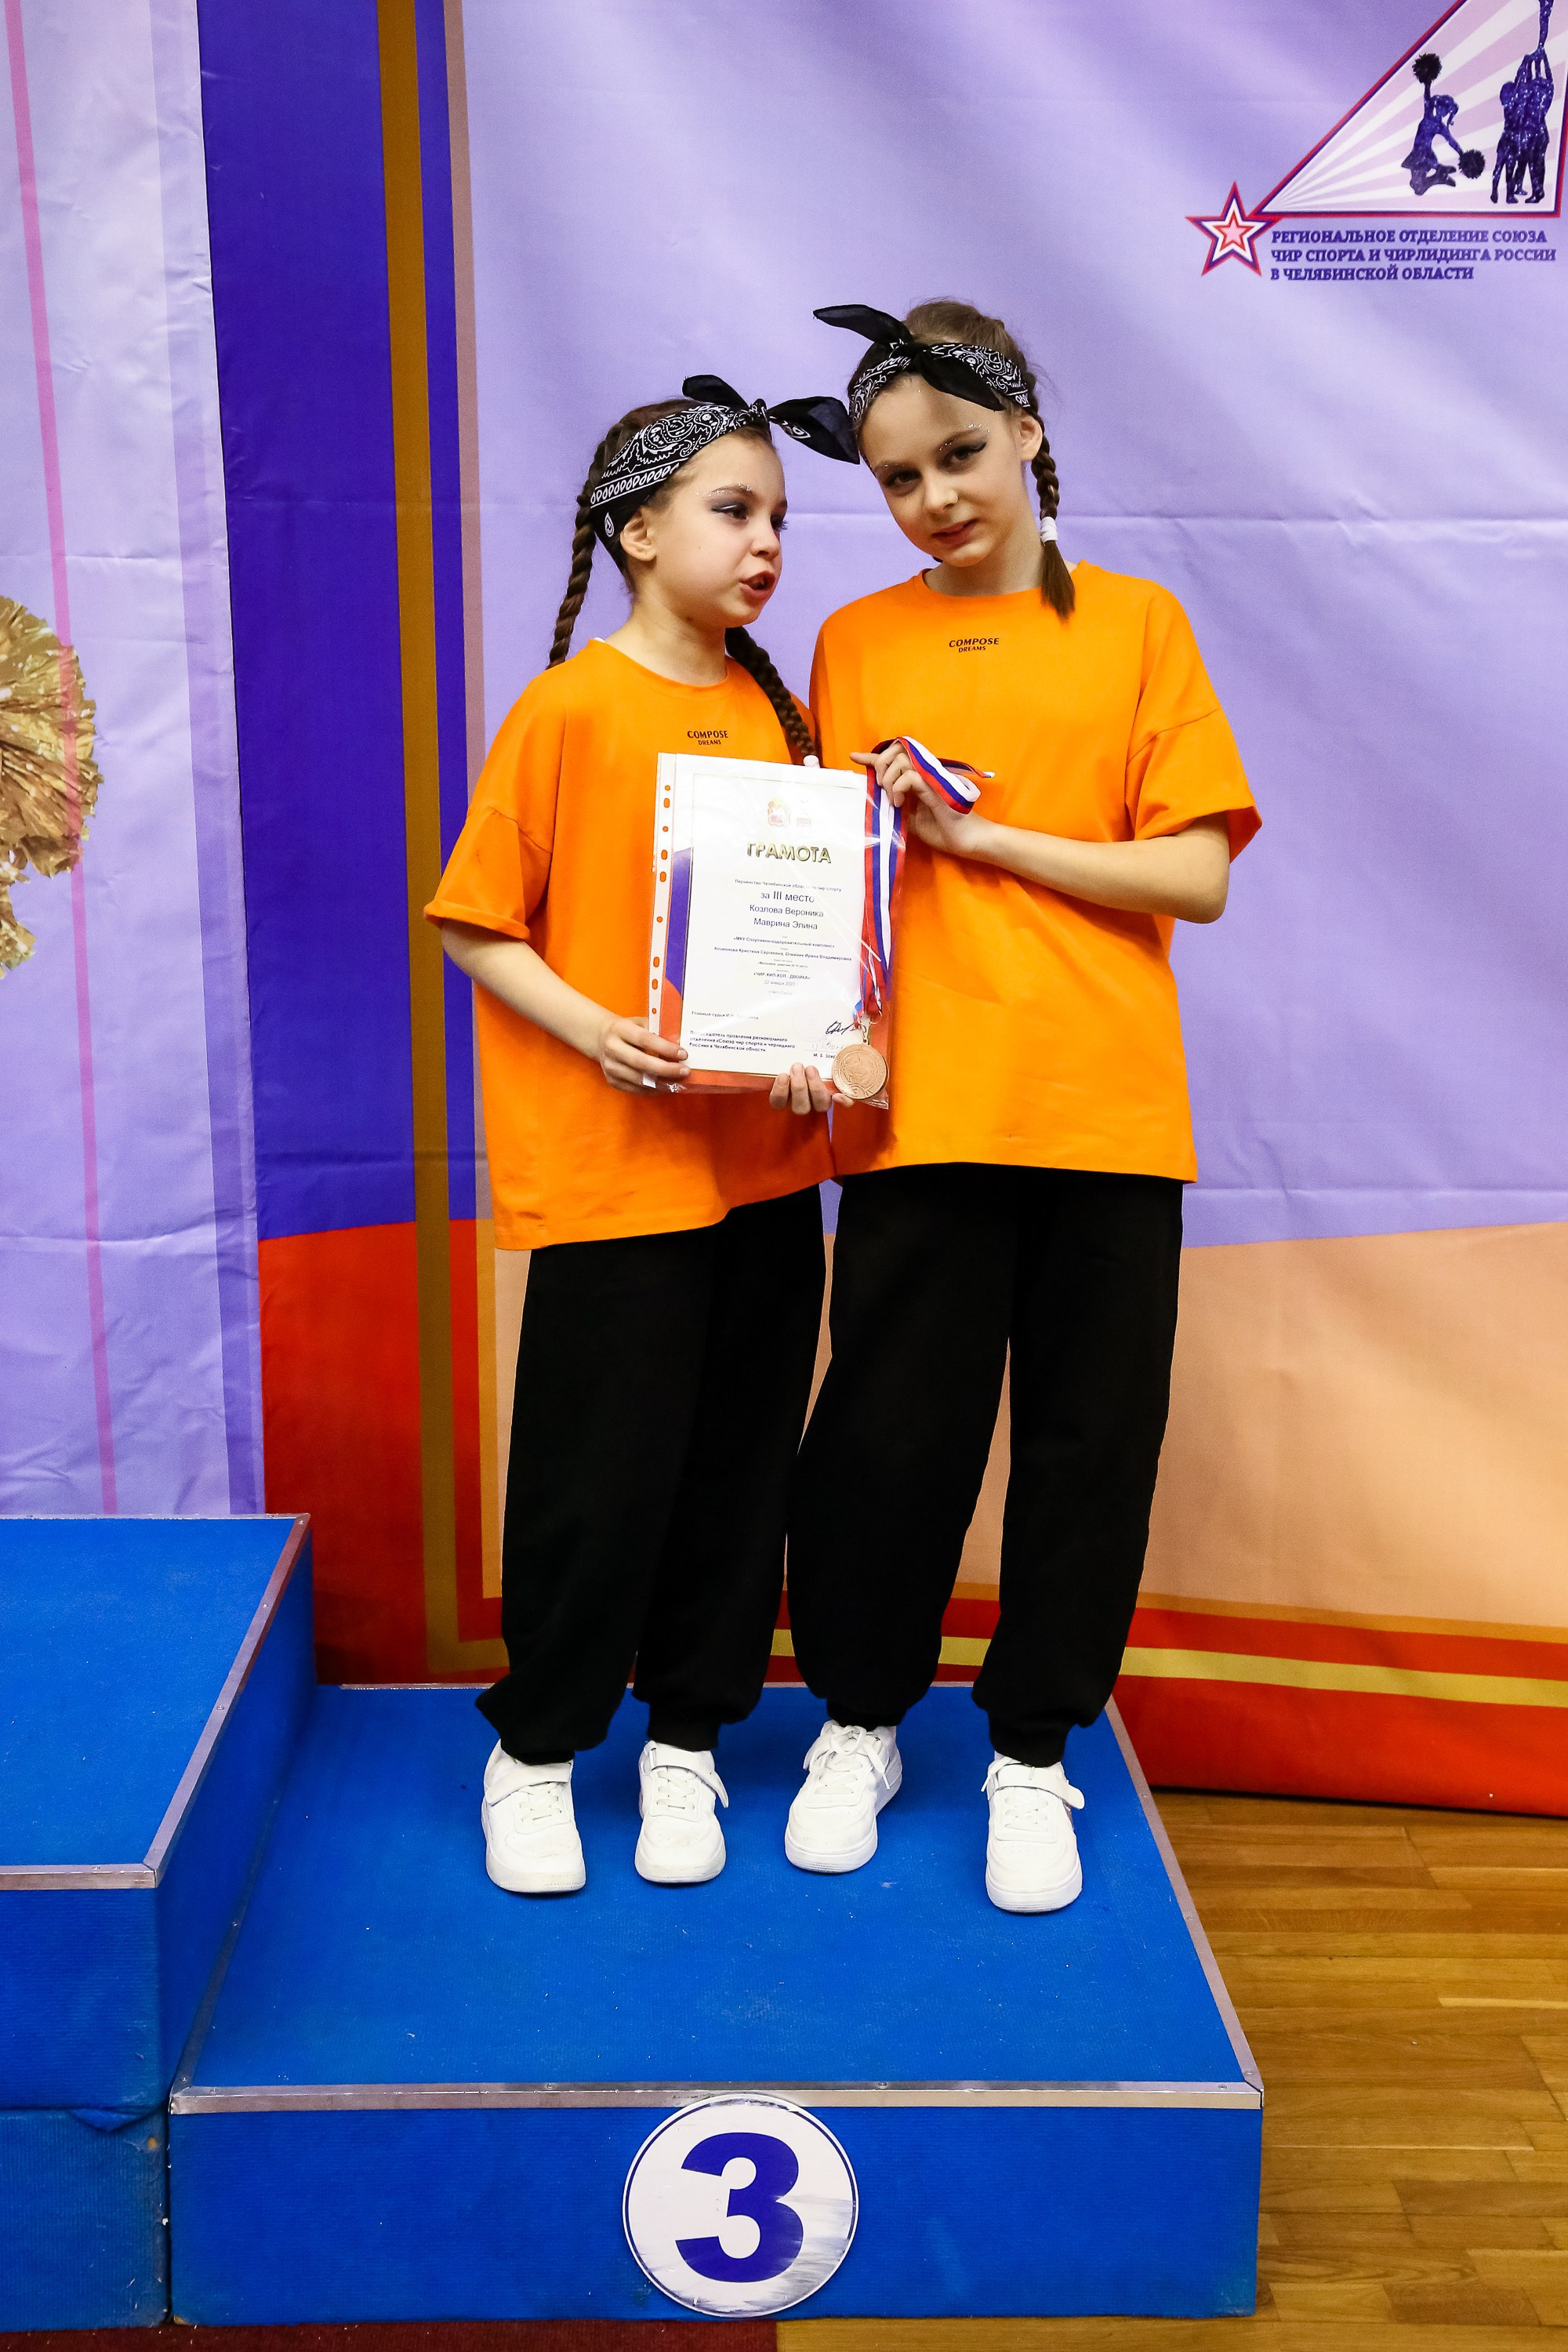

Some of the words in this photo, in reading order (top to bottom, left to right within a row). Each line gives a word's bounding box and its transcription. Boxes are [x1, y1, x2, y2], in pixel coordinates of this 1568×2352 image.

[1271, 230, 1396, 243] РЕГИОНАЛЬНОЕ
[1399, 230, 1489, 245] ОТДЕЛЕНИЕ
[1492, 230, 1548, 243] СОЮЗА
[1271, 249, 1302, 262] ЧИР
[1305, 249, 1366, 262] СПОРТА
[1368, 249, 1381, 262] И
[1385, 249, 1491, 263] ЧИРЛИДИНГА
[1494, 249, 1556, 261] РОССИИ
[1270, 267, 1279, 280] В
[1283, 263, 1398, 281] ЧЕЛЯБИНСКОЙ
[1402, 267, 1474, 280] ОБЛАСТИ
[949, 637, 1000, 648] COMPOSE
[687, 730, 728, 739] COMPOSE
[746, 840, 832, 863] ГРАМОТА
[773, 891, 782, 900] III
[785, 894, 815, 902] место
[750, 904, 783, 914] Козлова
[785, 906, 824, 916] Вероника
[753, 917, 790, 927] Маврина
[792, 920, 818, 930] Элина
[675, 2132, 804, 2283] 3
